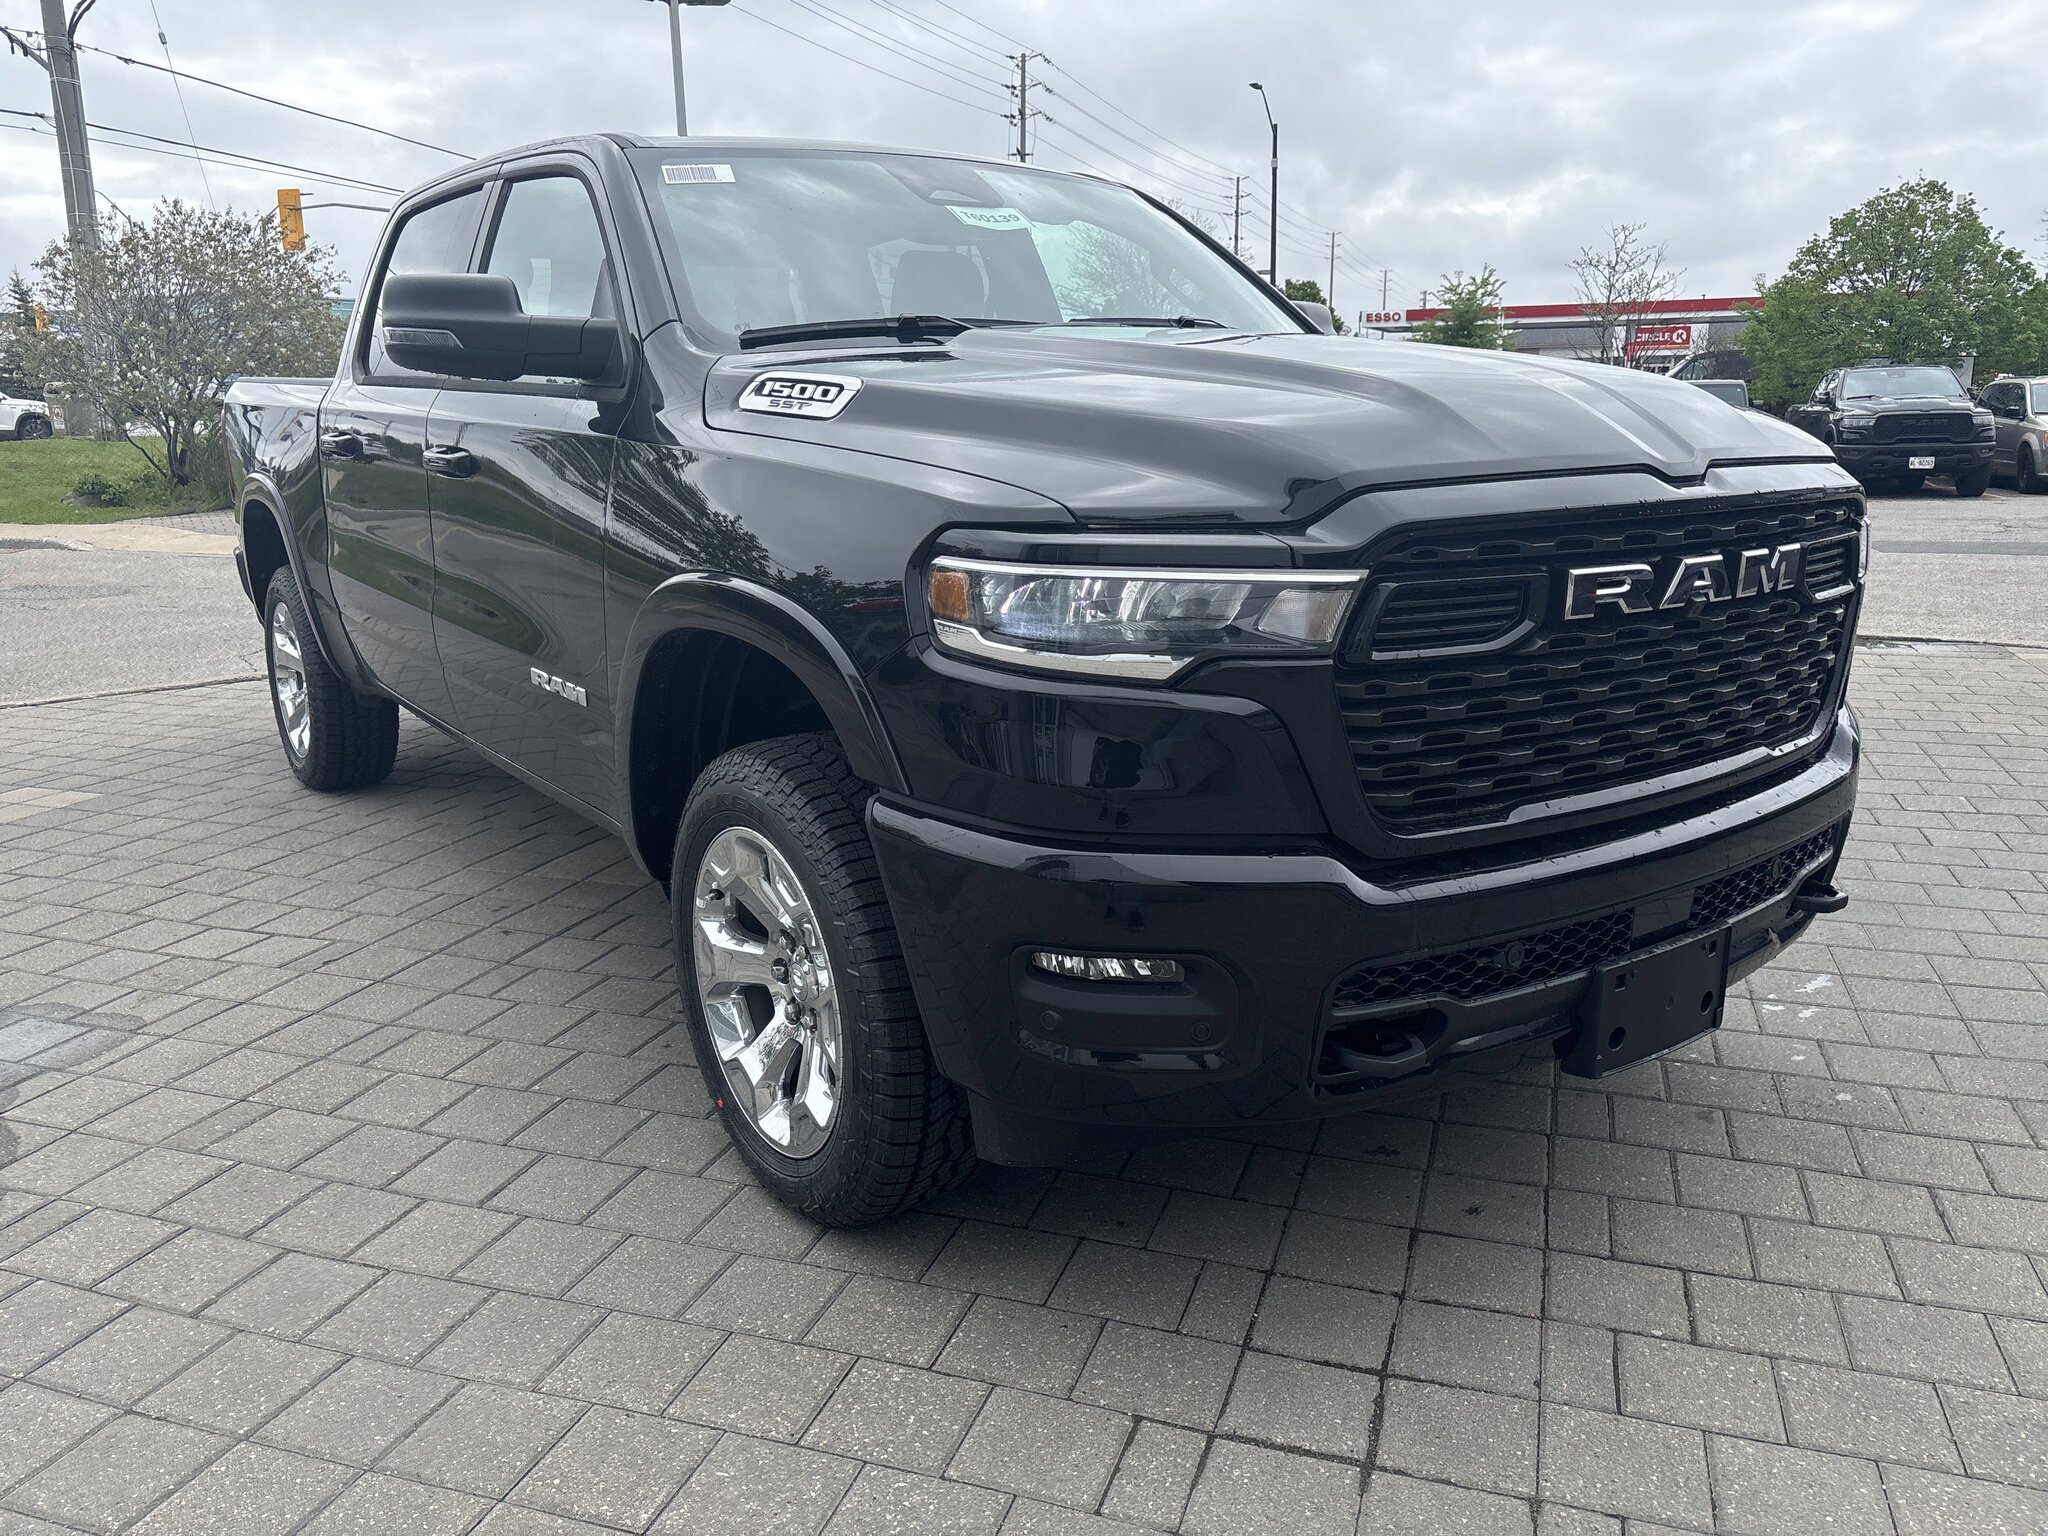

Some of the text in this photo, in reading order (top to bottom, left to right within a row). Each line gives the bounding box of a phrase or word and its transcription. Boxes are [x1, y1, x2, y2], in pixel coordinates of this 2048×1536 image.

[960, 210, 1020, 223] T60139
[1366, 312, 1402, 323] ESSO
[1636, 330, 1687, 342] CIRCLE K
[761, 381, 840, 401] 1500
[768, 398, 812, 410] SST
[1564, 542, 1801, 620] RAM
[530, 666, 588, 708] RAM
